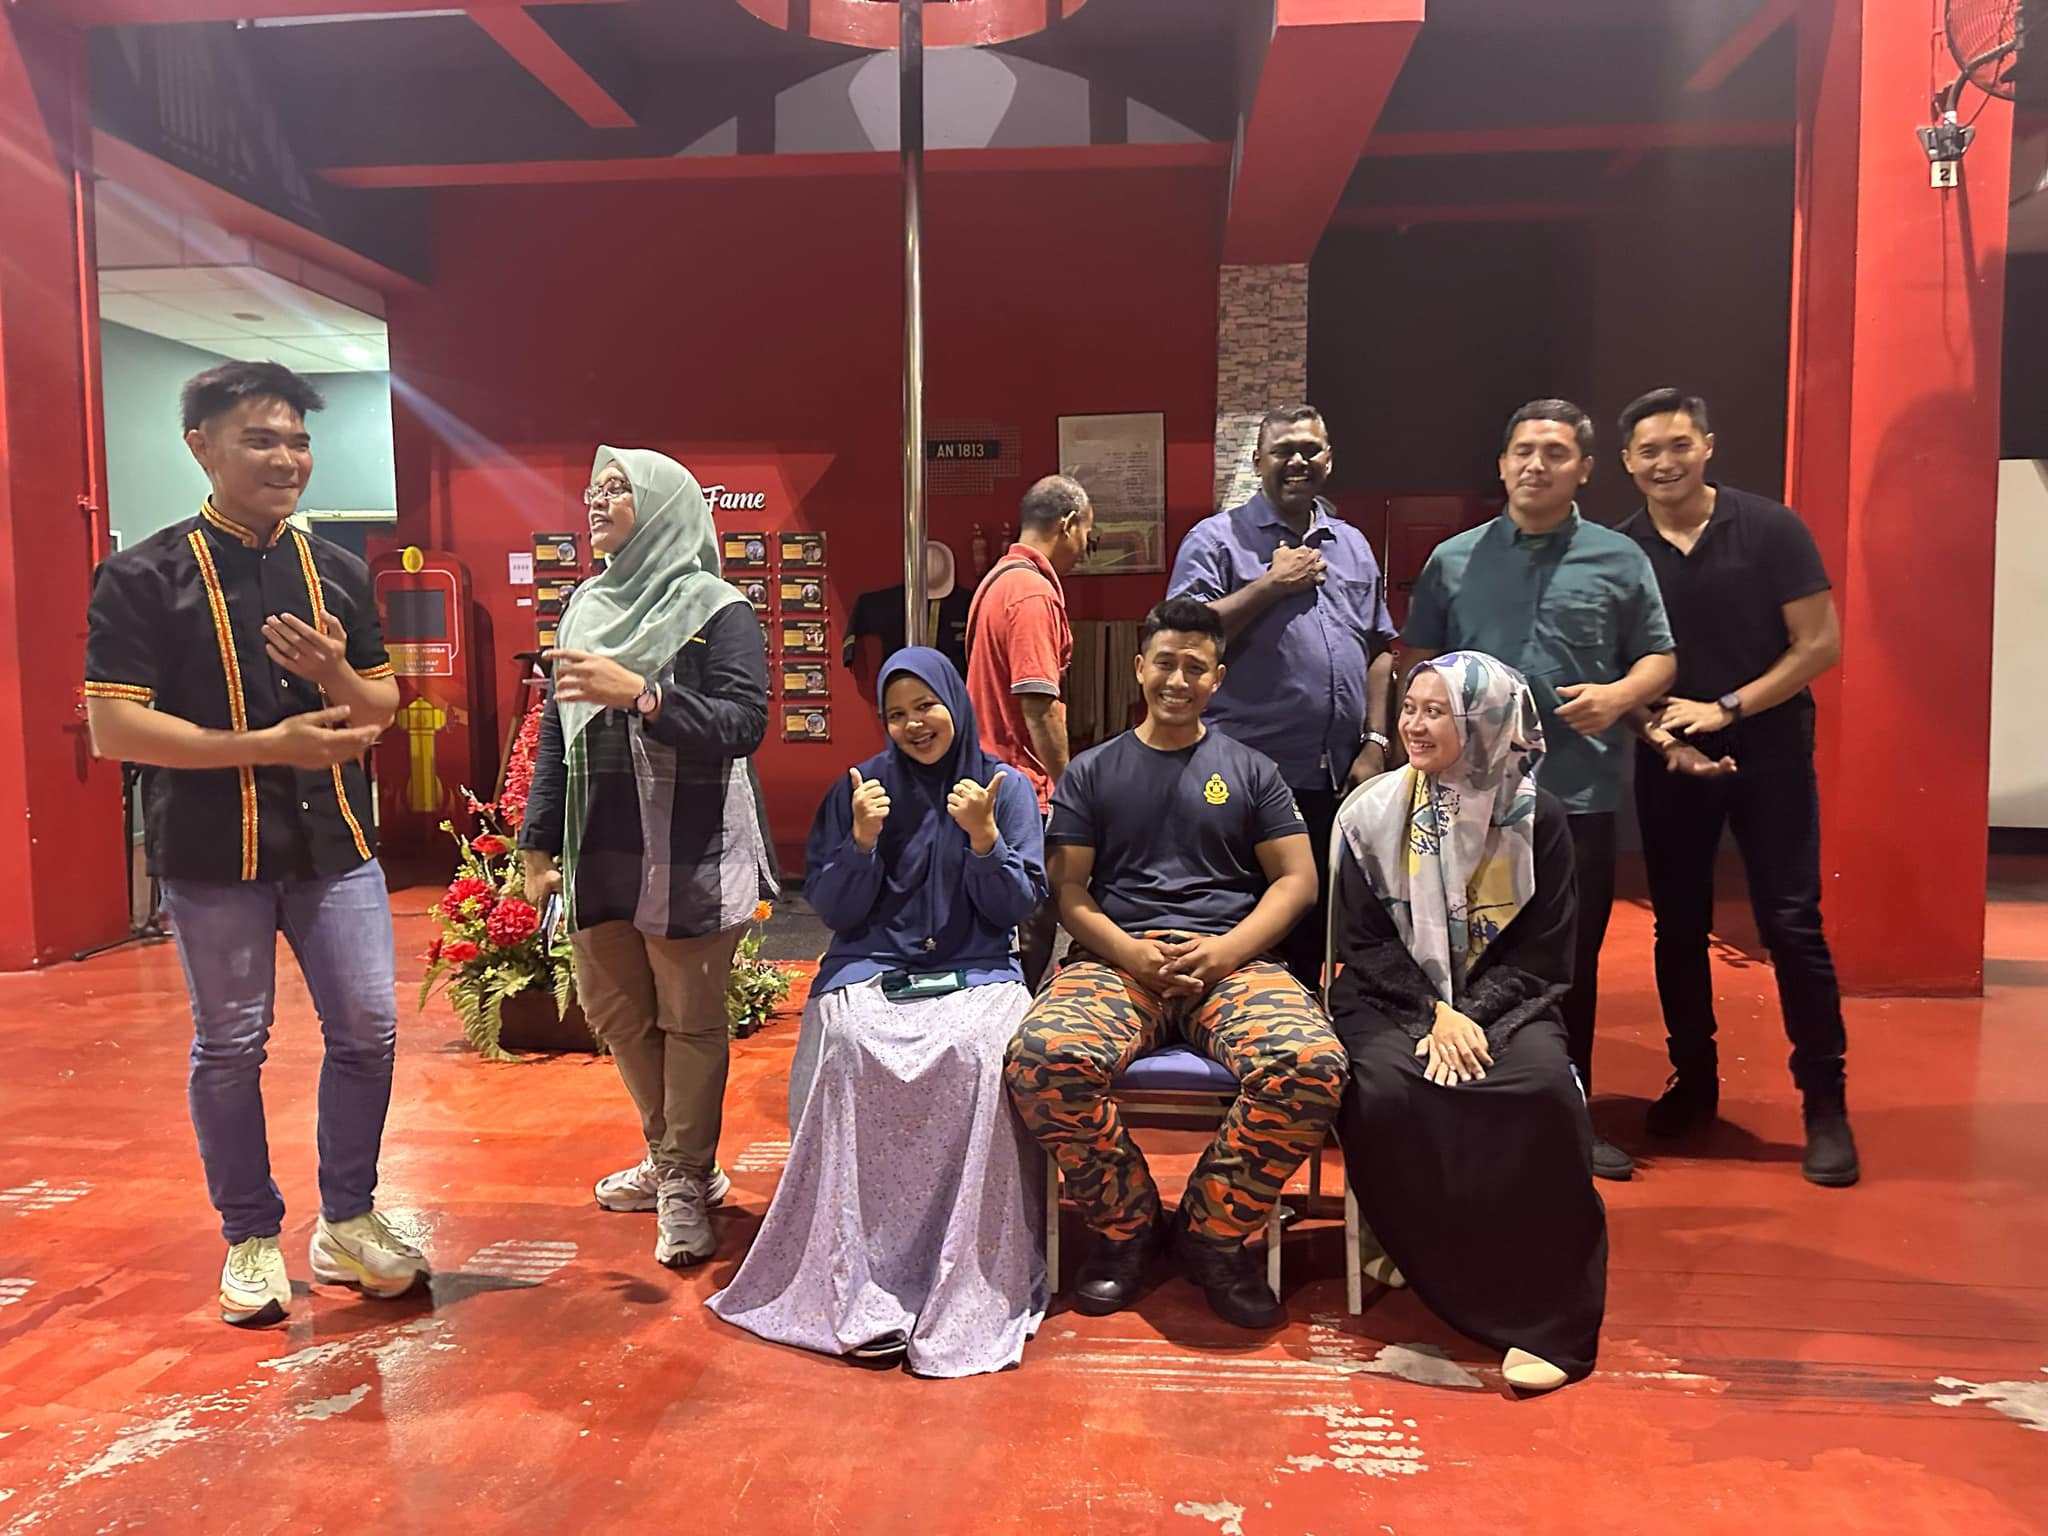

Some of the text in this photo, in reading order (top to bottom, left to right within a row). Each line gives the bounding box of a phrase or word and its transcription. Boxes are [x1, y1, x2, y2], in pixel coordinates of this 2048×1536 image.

[1940, 168, 1950, 181] 2
[937, 443, 985, 458] AN 1813
[703, 484, 765, 513] Fame
